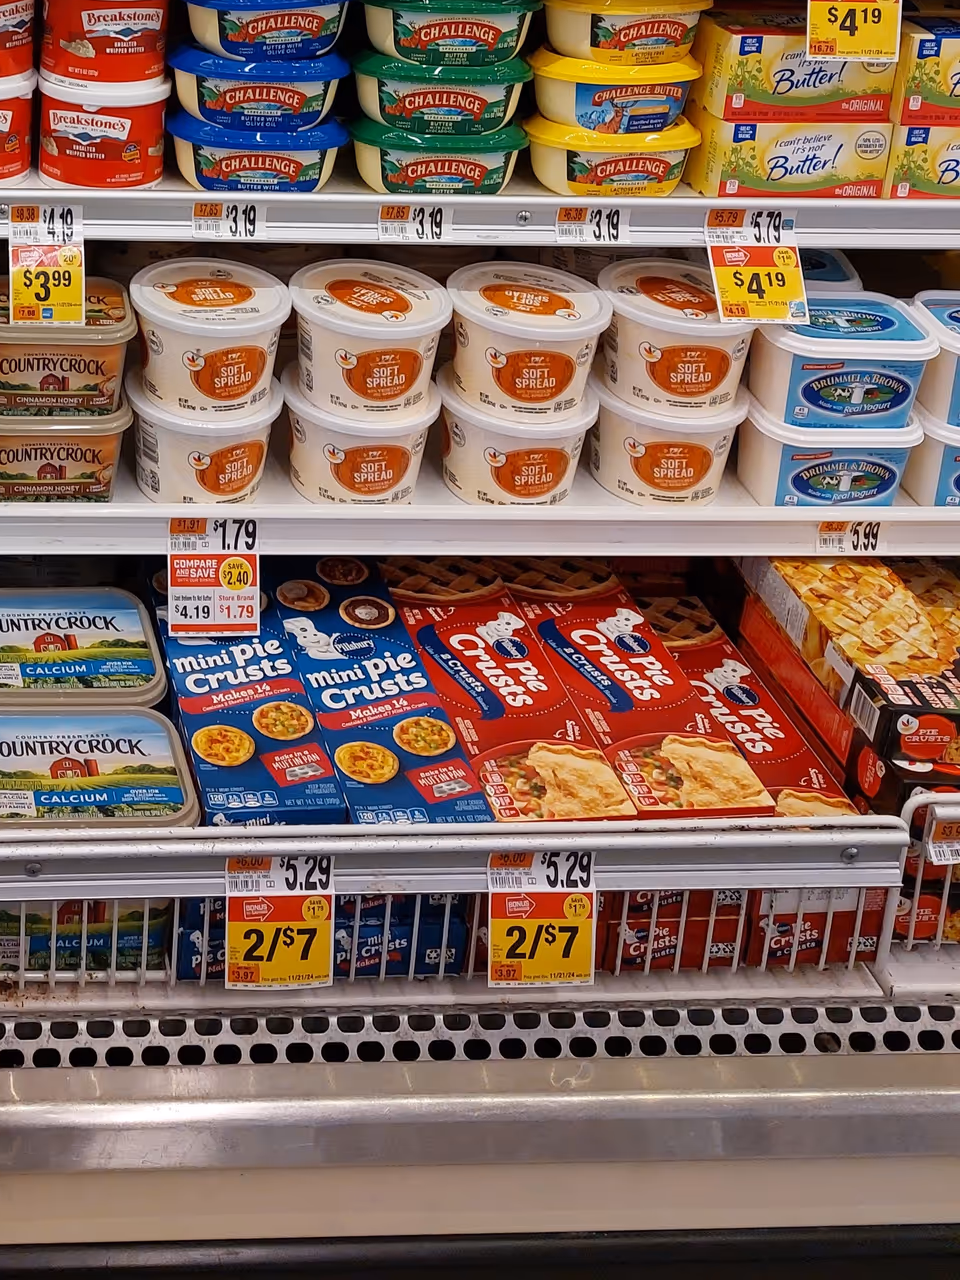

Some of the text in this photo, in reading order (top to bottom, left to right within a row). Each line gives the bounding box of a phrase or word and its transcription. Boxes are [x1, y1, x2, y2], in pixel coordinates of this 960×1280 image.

[768, 146, 843, 182] Butter!
[844, 186, 878, 198] ORIGINAL
[227, 205, 256, 238] $3.19
[750, 212, 782, 244] $5.79
[522, 369, 551, 380] SOFT
[813, 372, 906, 394] BRUMMEL & BROWN
[515, 378, 557, 391] SPREAD
[214, 520, 257, 551] $1.79
[174, 559, 218, 570] COMPARE
[190, 568, 217, 579] SAVE
[175, 605, 211, 620] $4.19
[220, 605, 255, 620] $1.79
[173, 637, 285, 674] mini pie
[335, 639, 376, 660] Pillsbury
[26, 665, 87, 676] CALCIUM
[186, 658, 294, 695] Crusts
[212, 683, 271, 704] Makes 14
[905, 735, 951, 743] CRUSTS
[919, 729, 940, 738] PIE
[272, 752, 321, 771] MUFFIN PAN
[244, 928, 319, 962] 2/$7
[495, 969, 517, 979] $3.97
